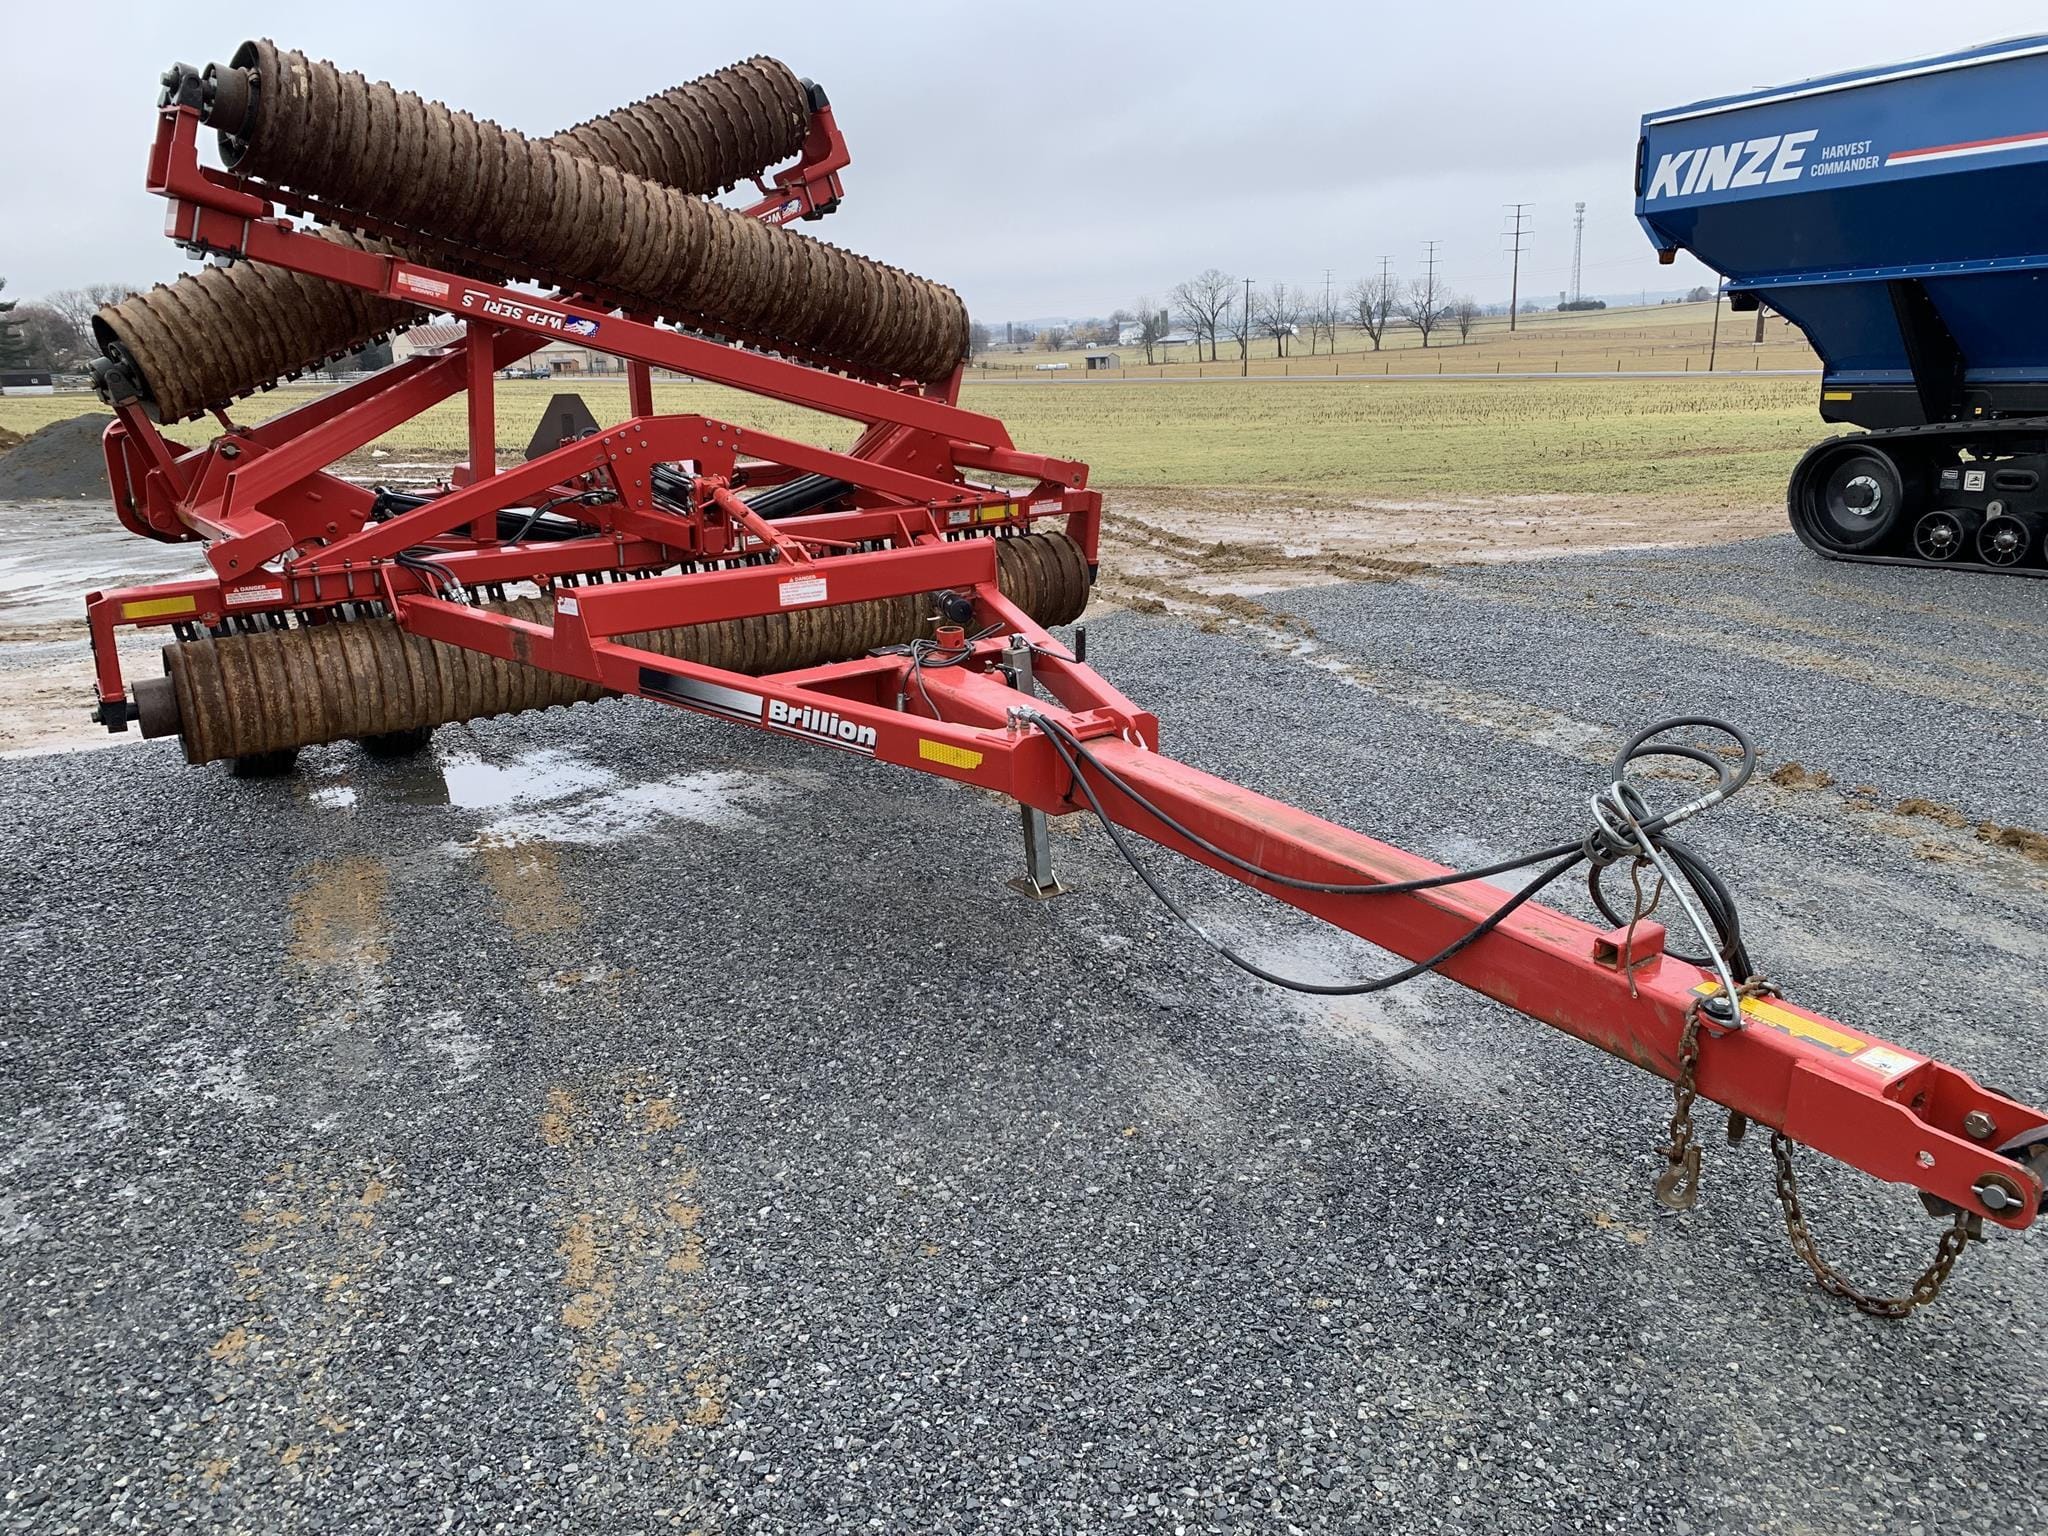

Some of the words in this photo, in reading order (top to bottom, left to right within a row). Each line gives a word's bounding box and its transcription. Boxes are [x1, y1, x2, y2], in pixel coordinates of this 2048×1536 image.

[1821, 140, 1873, 160] HARVEST
[1645, 128, 1819, 201] KINZE
[1810, 155, 1880, 177] COMMANDER
[526, 312, 562, 330] WFP
[240, 584, 267, 592] DANGER
[768, 698, 877, 746] Brillion
